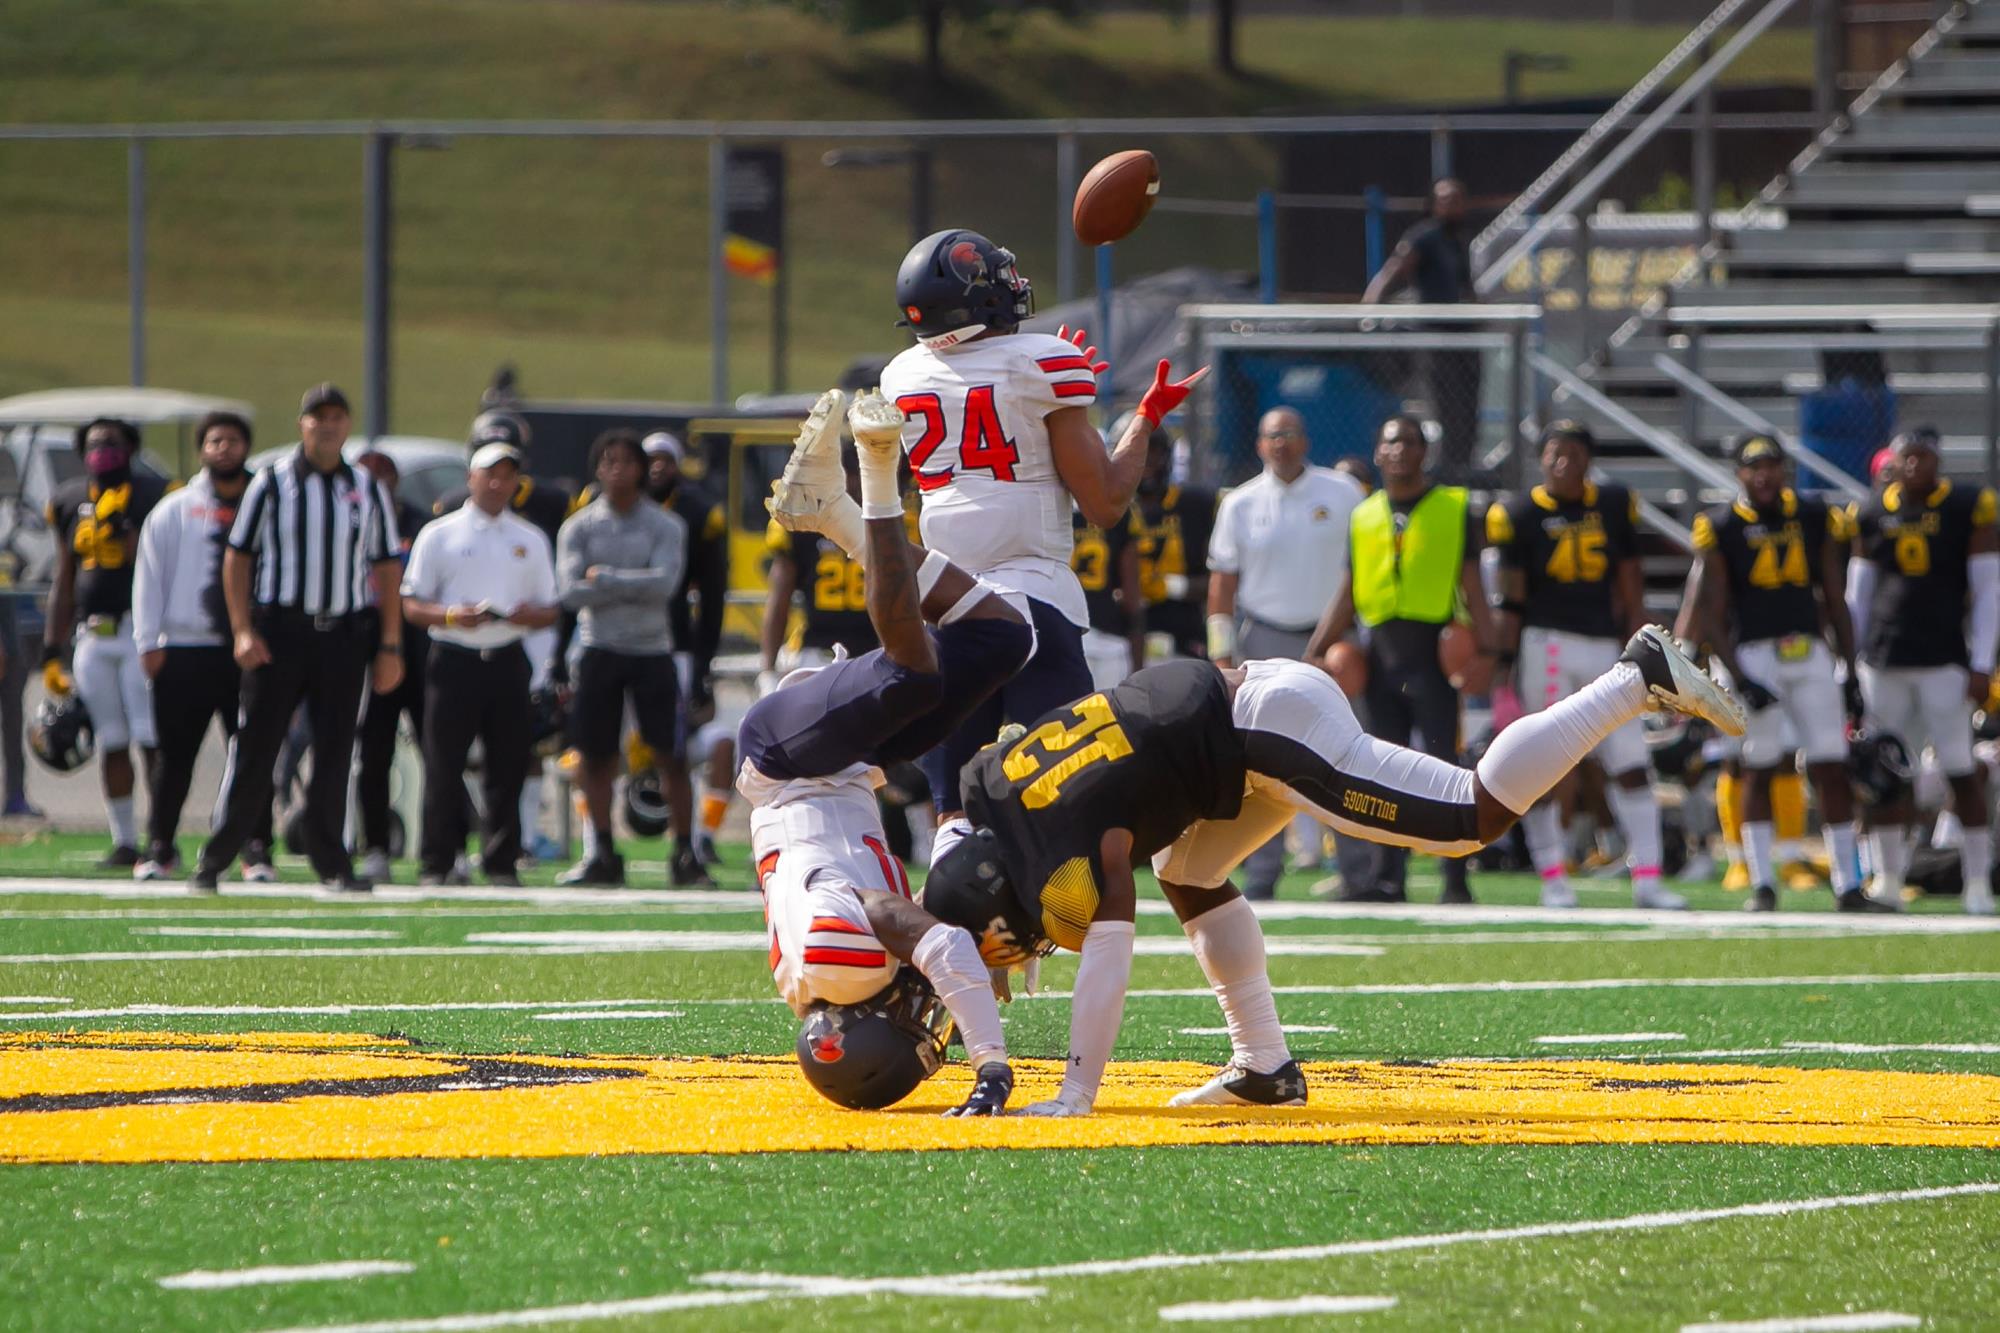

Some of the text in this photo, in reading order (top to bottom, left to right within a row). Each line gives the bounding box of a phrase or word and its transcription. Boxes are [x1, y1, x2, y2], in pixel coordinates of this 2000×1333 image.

[896, 384, 1020, 491] 24
[1546, 531, 1609, 582] 45
[1750, 534, 1809, 588] 44
[1002, 692, 1135, 811] 12
[1343, 789, 1398, 822] BULLDOGS
